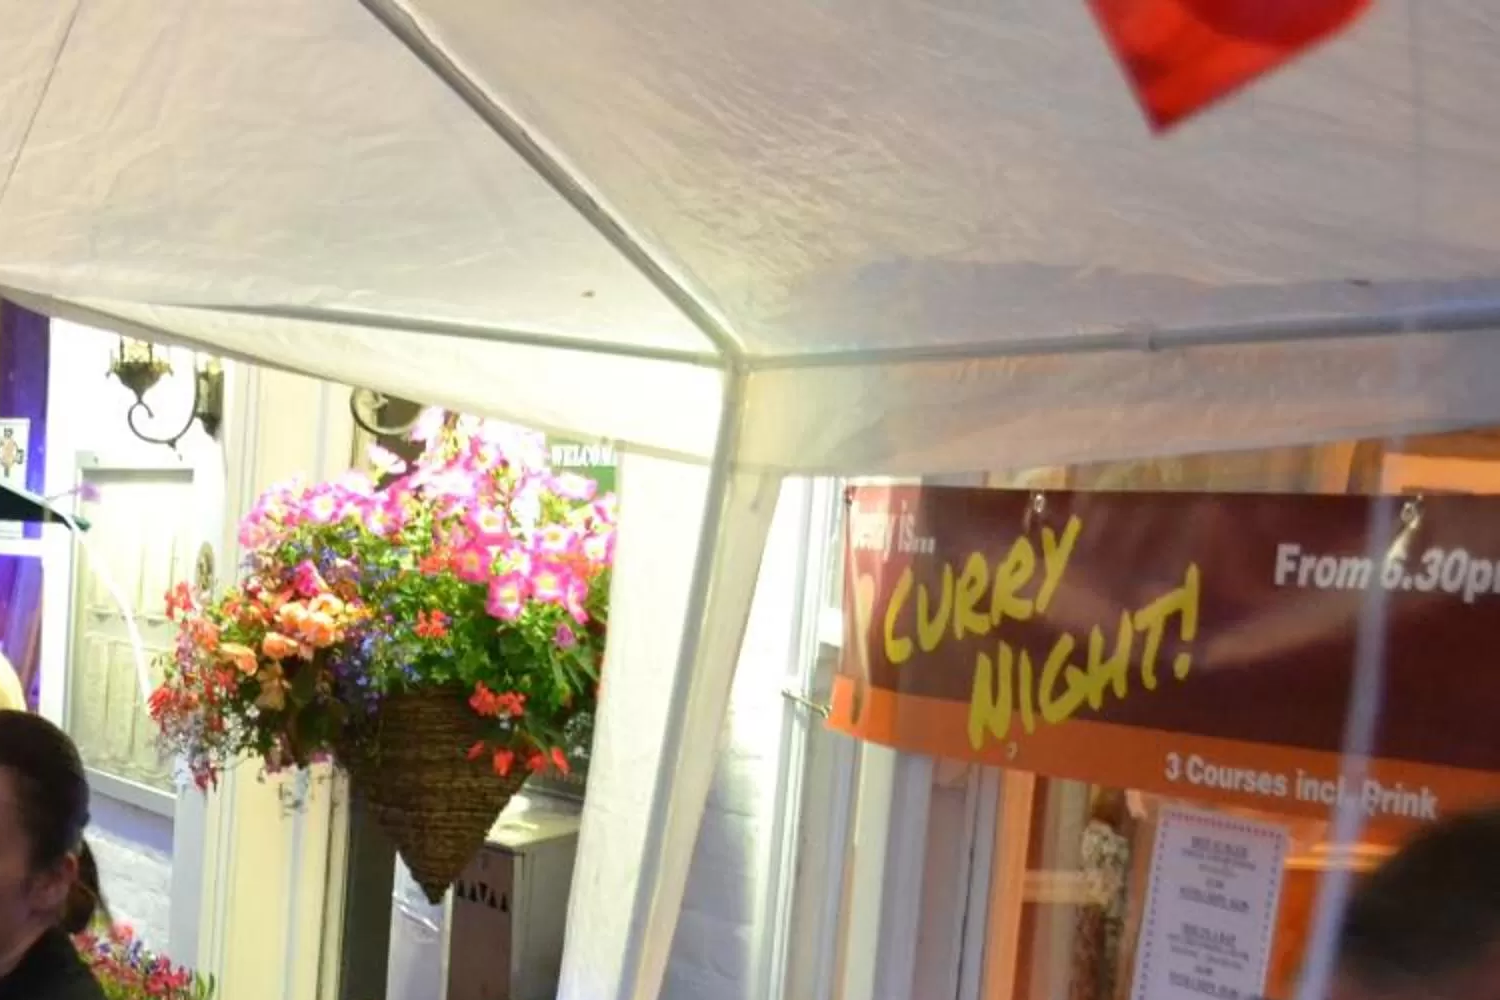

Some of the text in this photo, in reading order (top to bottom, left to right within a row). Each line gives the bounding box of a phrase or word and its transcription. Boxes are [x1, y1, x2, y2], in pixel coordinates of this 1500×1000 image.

[884, 514, 1083, 663] CURRY
[1274, 542, 1373, 589] From
[967, 561, 1200, 751] NIGHT!
[1164, 752, 1181, 781] 3
[1186, 754, 1288, 798] Courses
[1362, 779, 1440, 821] Drink
